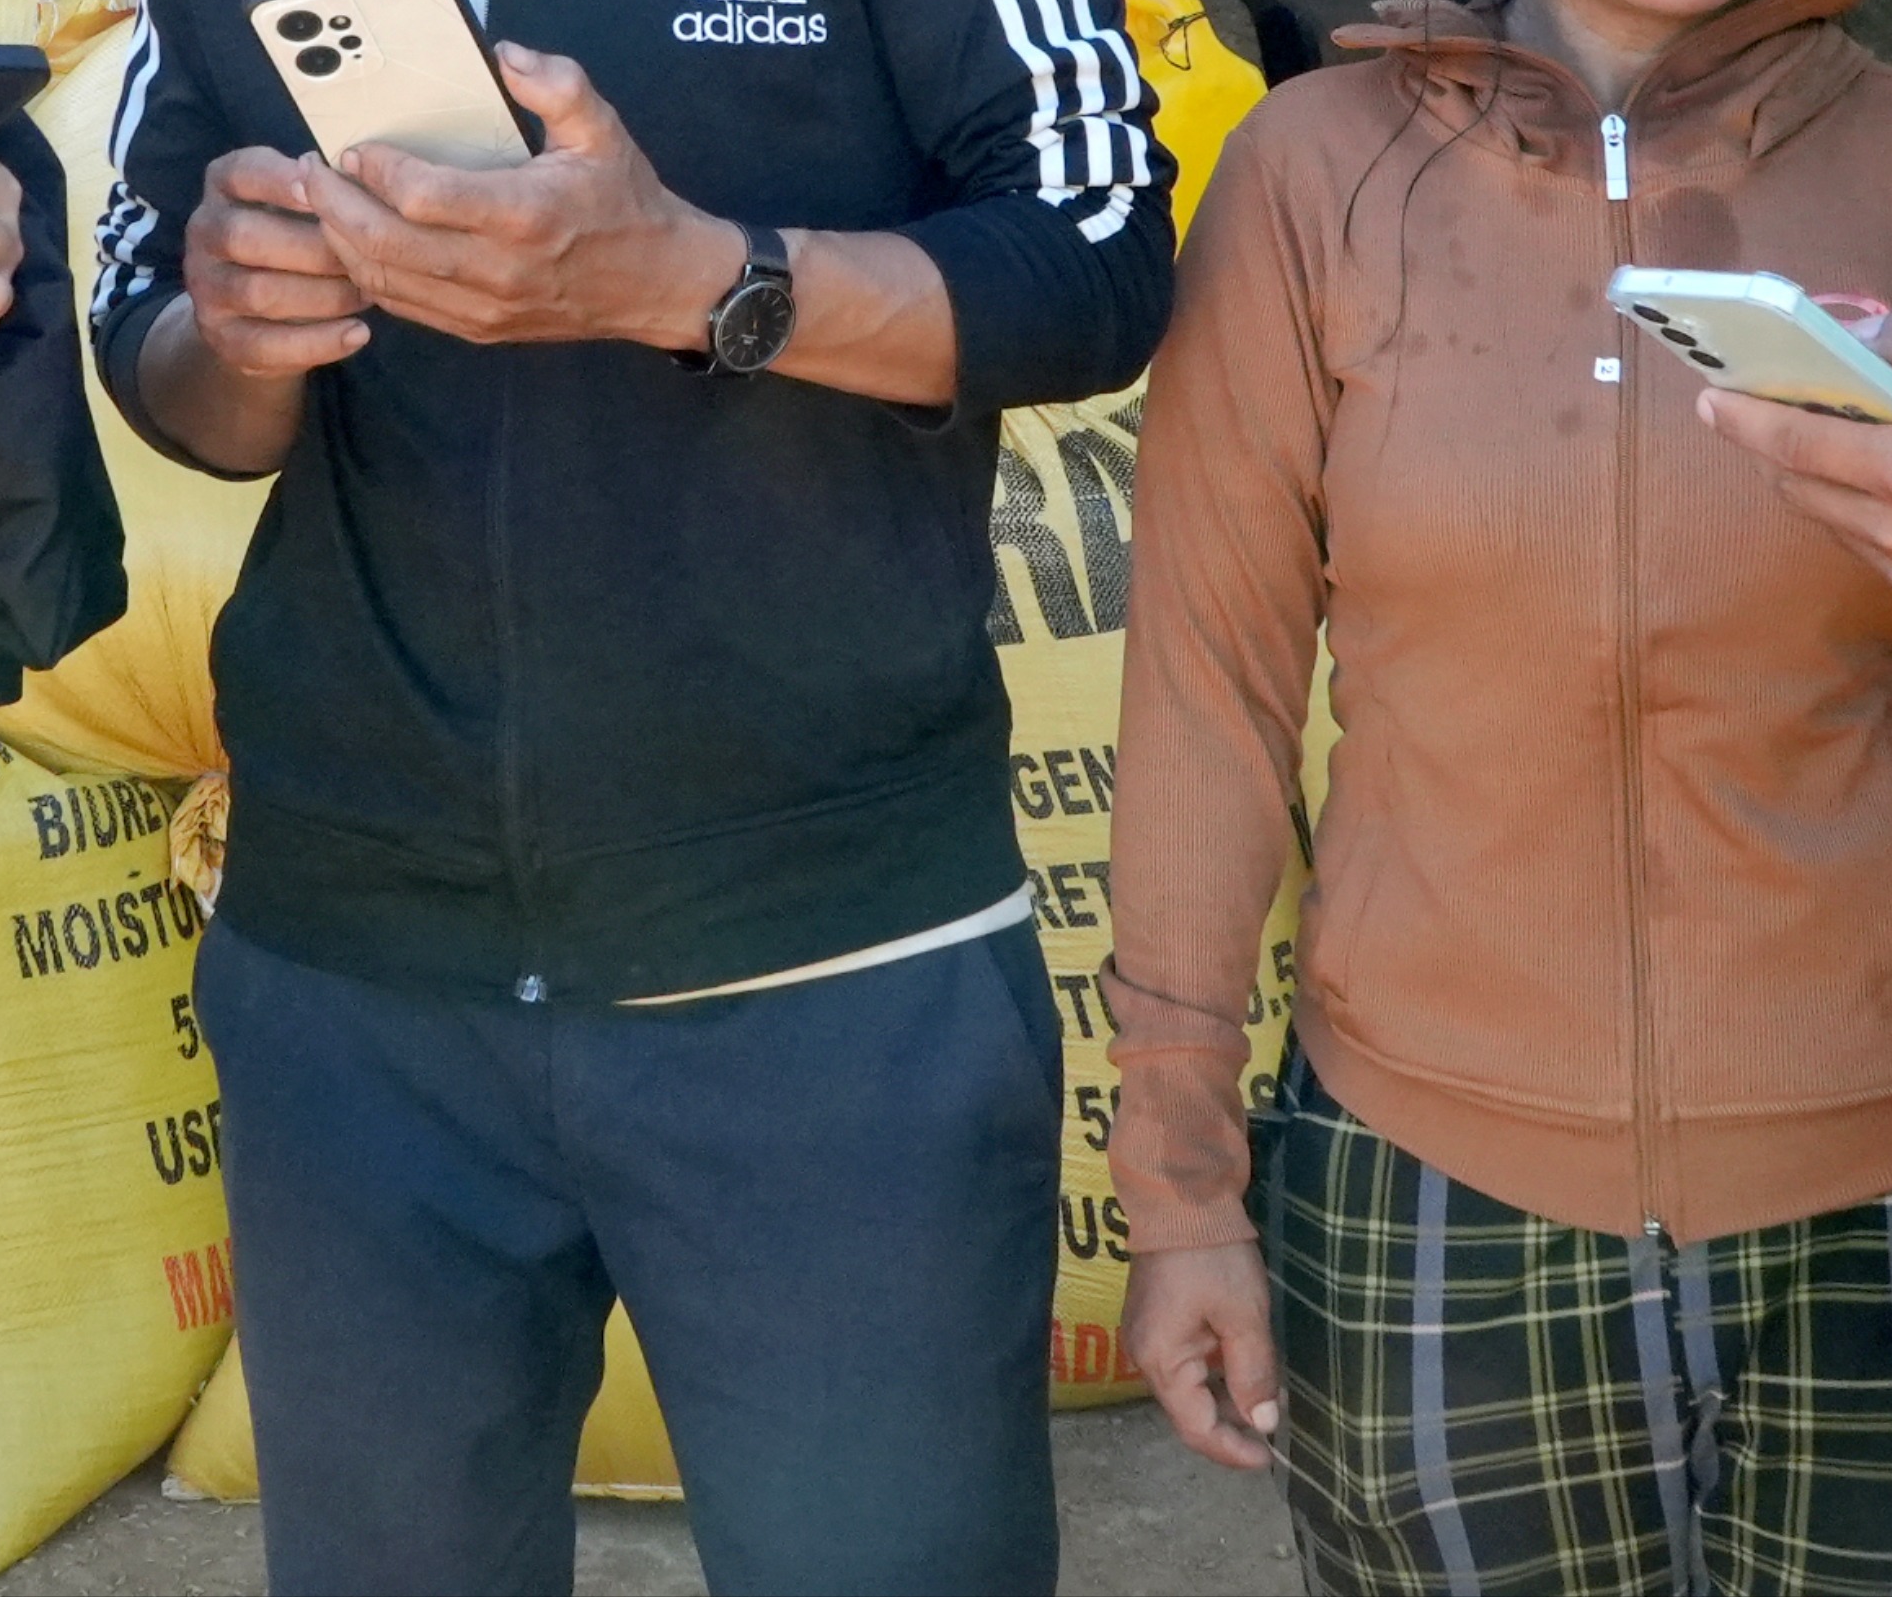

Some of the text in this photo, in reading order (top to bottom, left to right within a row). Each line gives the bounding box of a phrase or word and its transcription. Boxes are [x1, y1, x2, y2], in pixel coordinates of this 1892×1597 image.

[672, 0, 828, 45] adidas
[28, 776, 170, 861] BIURE
[12, 878, 206, 979] MOISTU
[163, 1236, 234, 1332] MA
